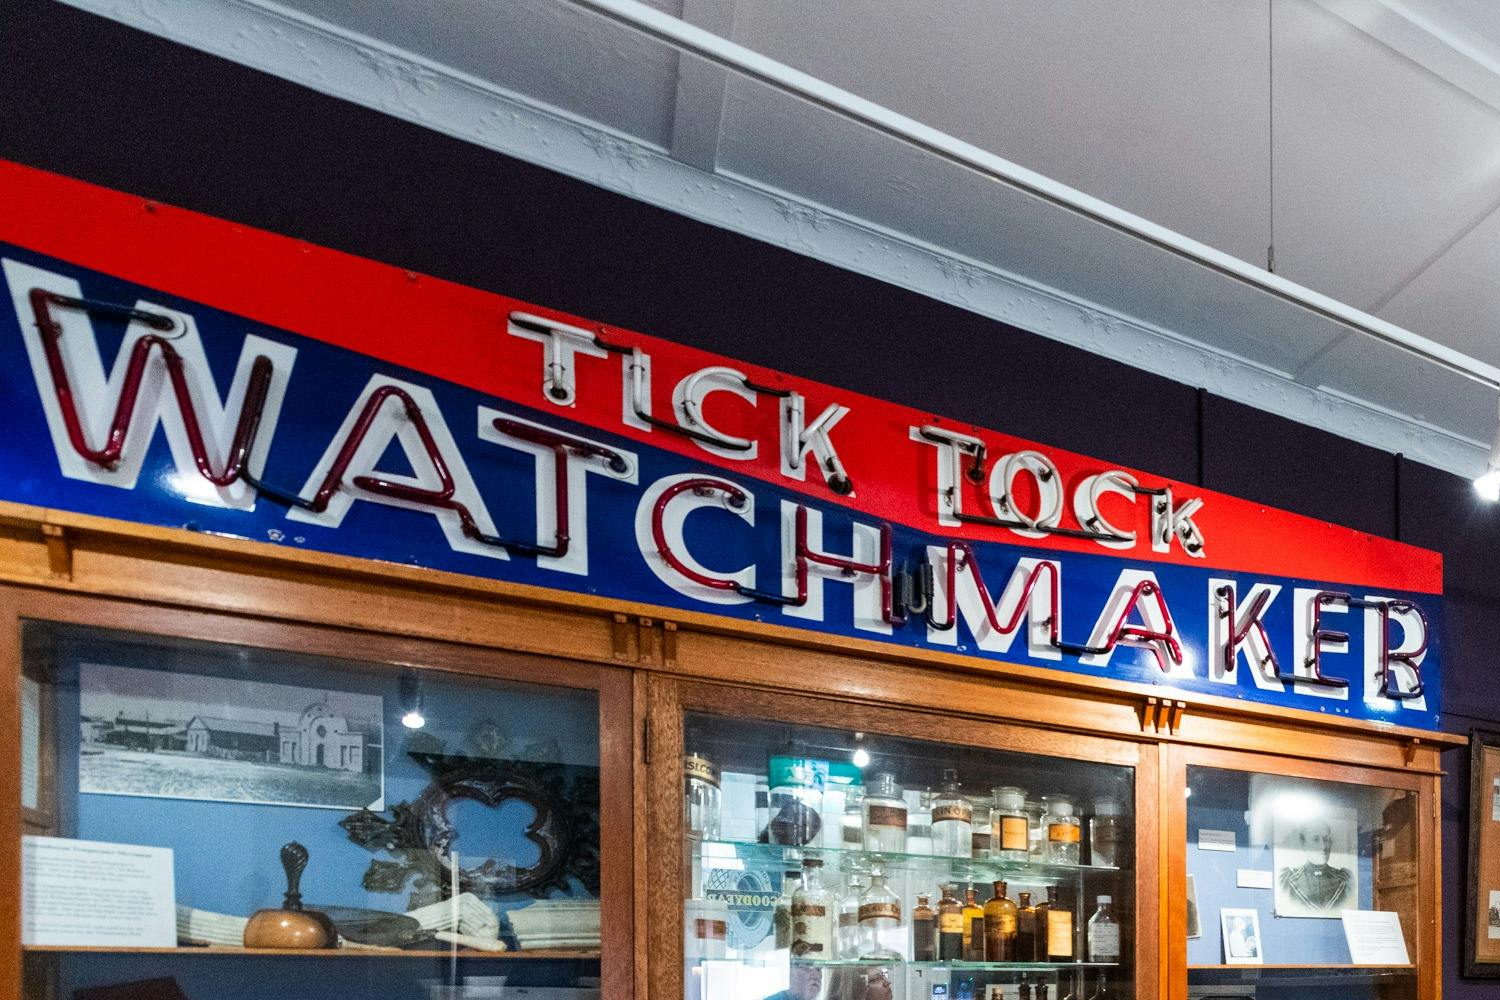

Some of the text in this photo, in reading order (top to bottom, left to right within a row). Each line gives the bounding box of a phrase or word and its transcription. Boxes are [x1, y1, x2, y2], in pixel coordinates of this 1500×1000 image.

[1, 256, 1428, 711] WATCHMAKER
[508, 311, 1206, 559] TICK TOCK
